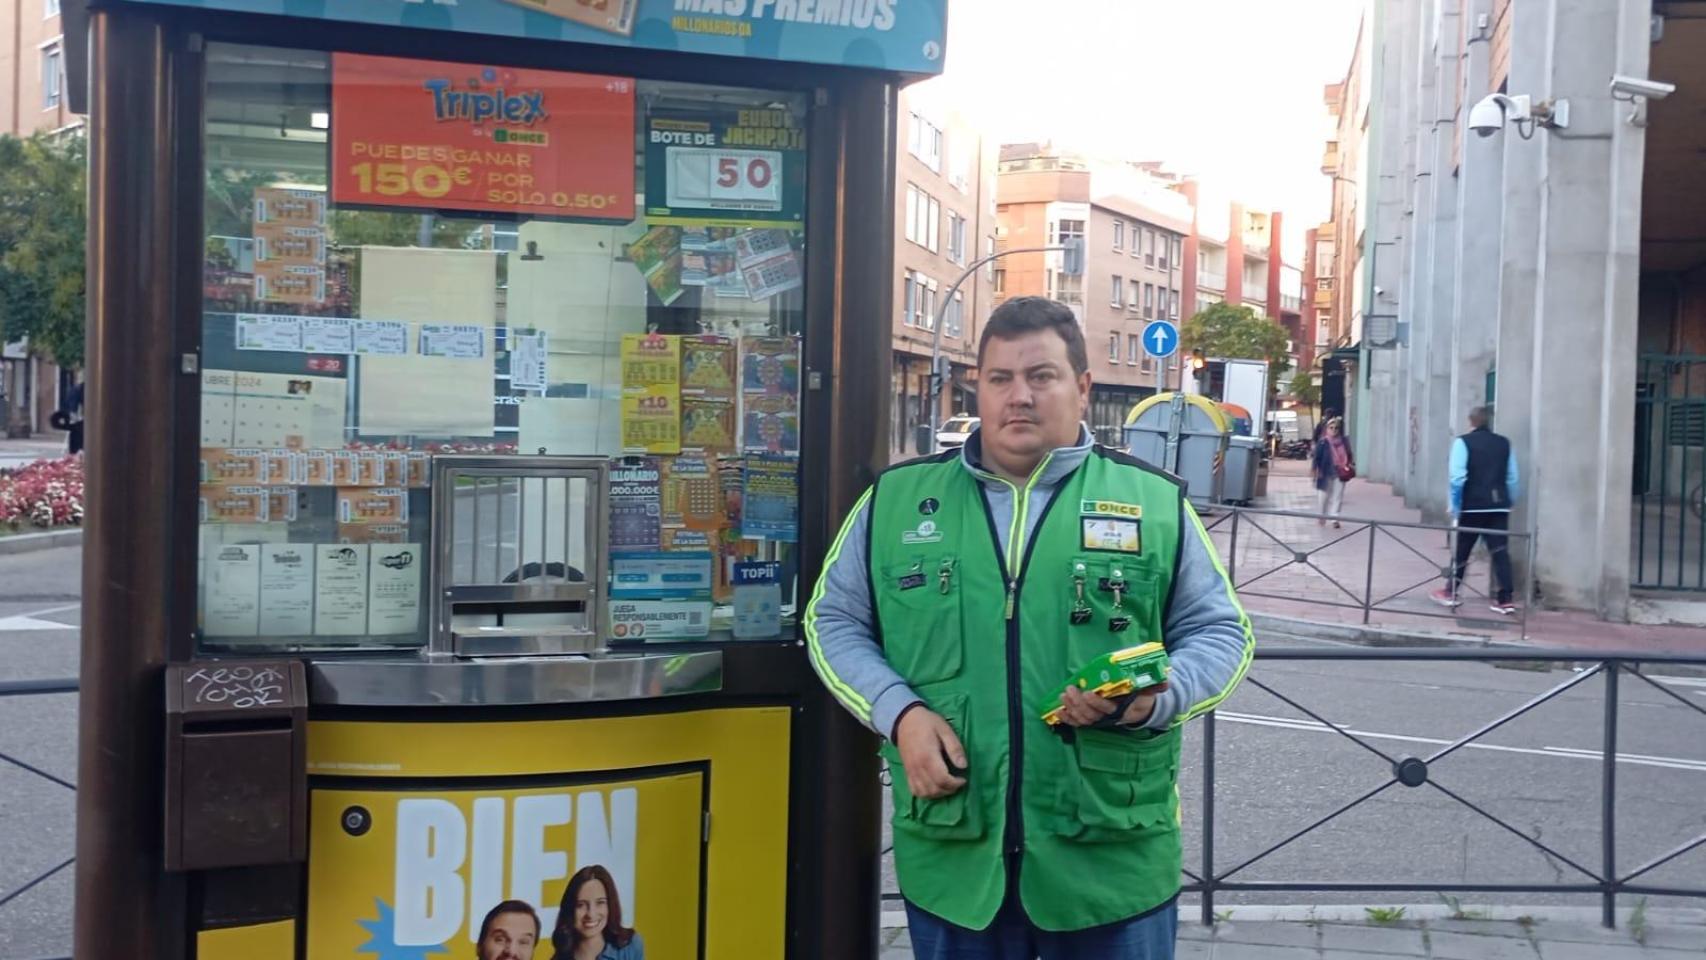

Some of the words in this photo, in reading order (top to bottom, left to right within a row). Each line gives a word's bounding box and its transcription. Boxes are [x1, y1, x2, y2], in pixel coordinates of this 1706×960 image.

[751, 0, 897, 31] PREMIOS
[605, 81, 629, 94] +18
[424, 79, 548, 126] Triplex
[738, 109, 784, 128] EURO
[509, 131, 546, 144] ONCE
[650, 130, 692, 145] BOTE
[694, 133, 716, 146] DE
[722, 127, 801, 149] JACKPOT
[351, 142, 449, 162] PUEDES
[450, 148, 532, 168] GANAR
[350, 161, 473, 198] 150€
[487, 172, 534, 188] POR
[716, 157, 772, 188] 50
[487, 189, 545, 205] SOLO
[1098, 502, 1139, 516] ONCE
[395, 788, 638, 946] BIEN
